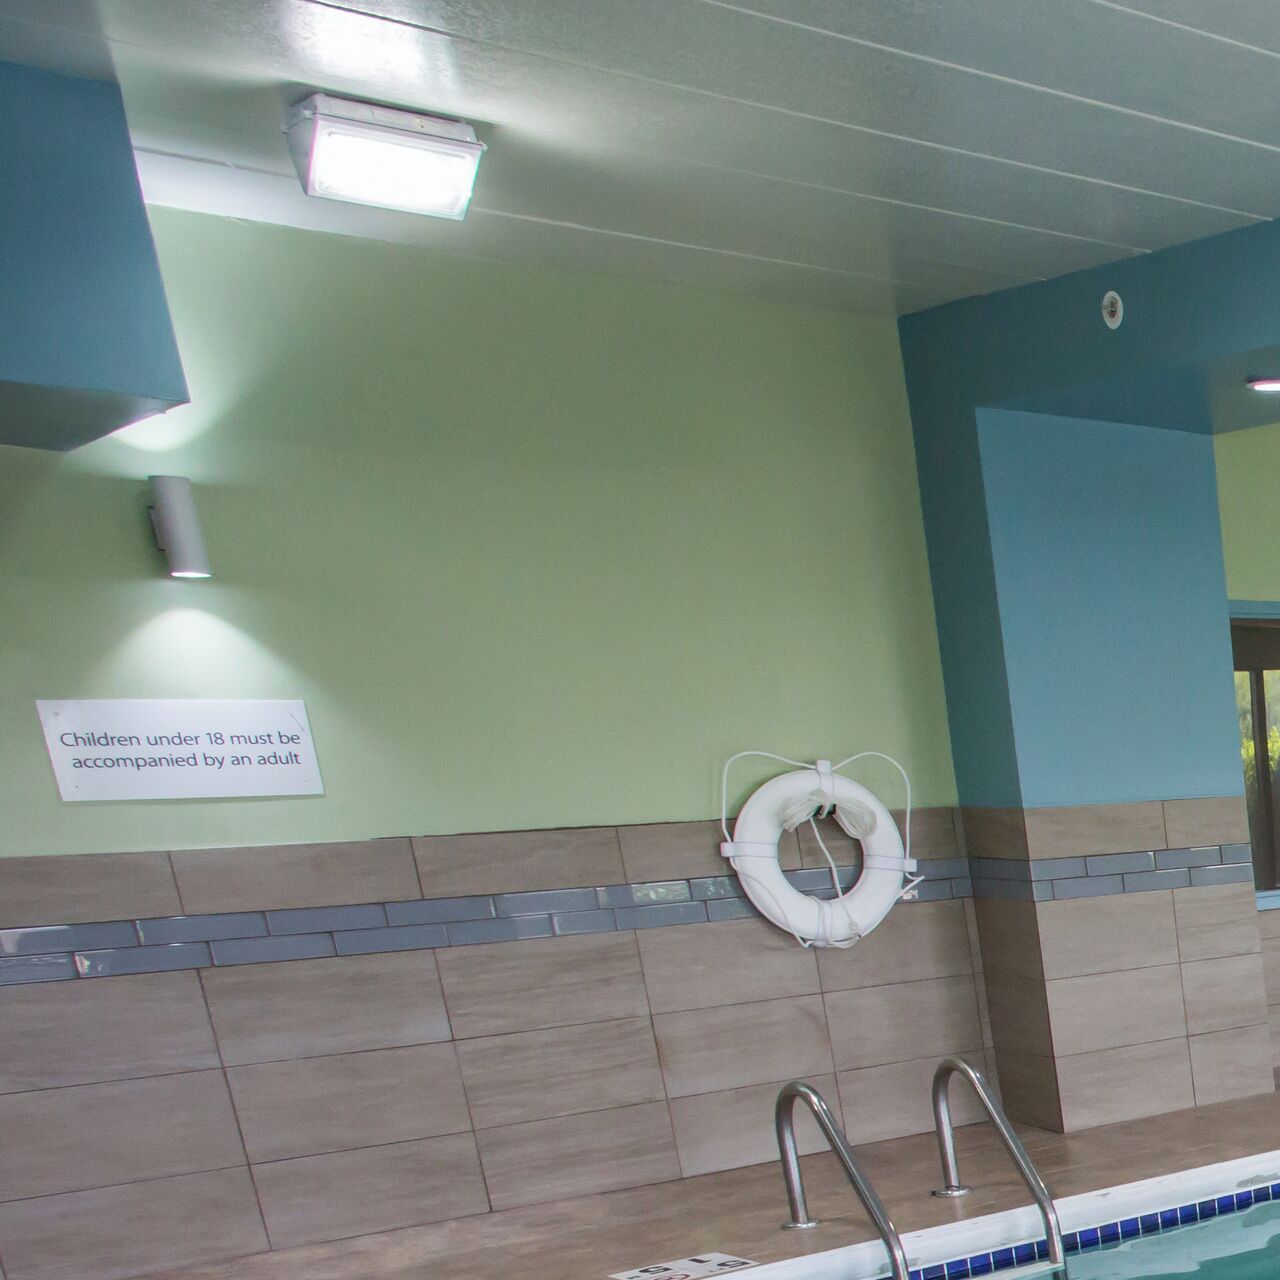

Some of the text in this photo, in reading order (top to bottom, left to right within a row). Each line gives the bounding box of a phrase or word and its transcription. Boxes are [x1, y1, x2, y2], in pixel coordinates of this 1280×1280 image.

[60, 731, 301, 747] Children under 18 must be
[72, 751, 302, 771] accompanied by an adult
